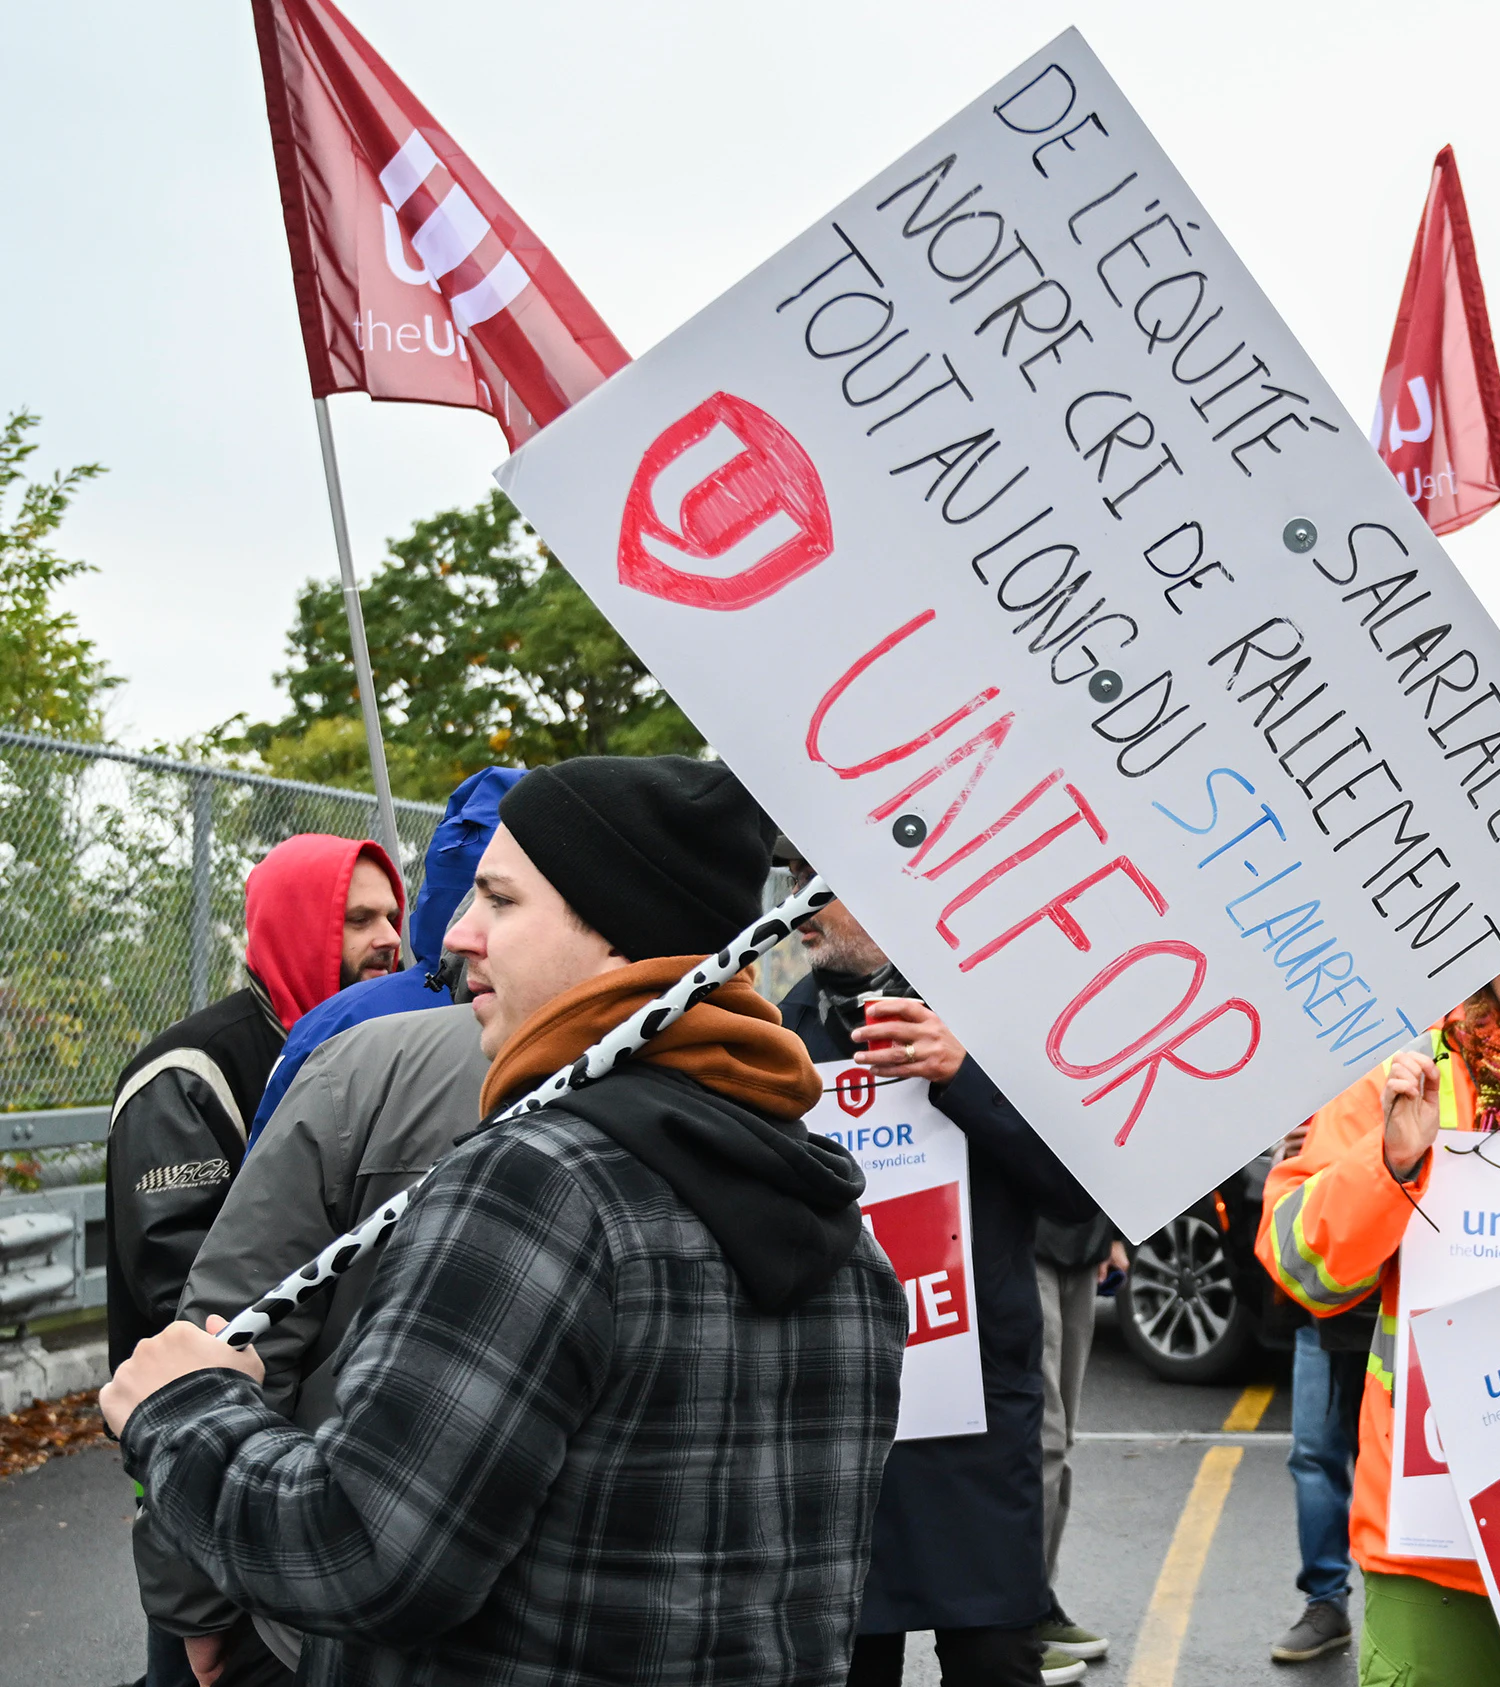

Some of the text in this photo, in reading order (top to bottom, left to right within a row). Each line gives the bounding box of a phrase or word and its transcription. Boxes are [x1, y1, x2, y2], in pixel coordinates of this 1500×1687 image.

[876, 154, 1093, 392] NOTRE
[1066, 392, 1183, 521] CRI
[1144, 520, 1235, 615] DE
[994, 64, 1108, 178] DE
[1069, 173, 1339, 477] L'ÉQUITÉ
[776, 222, 1418, 1067] TOUT AU LONG DU ST-LAURENT
[805, 609, 1261, 1147] UNIFOR
